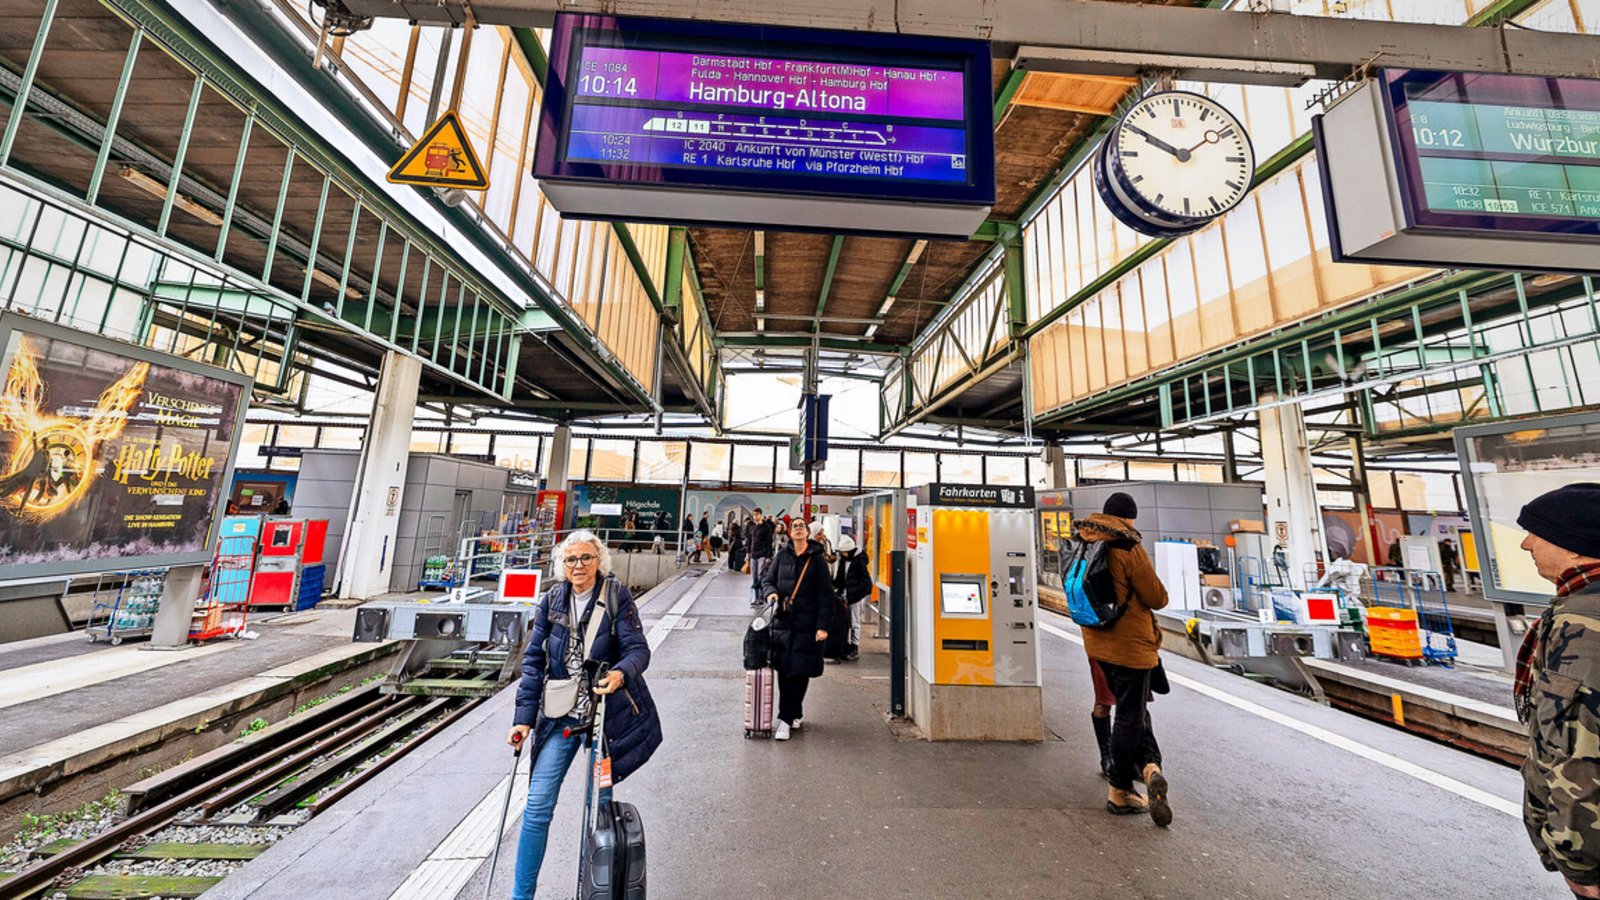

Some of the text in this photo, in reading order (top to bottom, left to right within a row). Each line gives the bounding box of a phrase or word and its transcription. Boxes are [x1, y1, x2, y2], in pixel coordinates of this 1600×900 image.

[603, 63, 628, 73] 1084
[692, 56, 750, 69] Darmstadt
[754, 61, 773, 71] Hbf
[784, 62, 871, 77] Frankfurt(M)Hbf
[883, 69, 916, 80] Hanau
[919, 72, 938, 81] Hbf
[580, 75, 637, 96] 10:14
[691, 68, 722, 80] Fulda
[733, 72, 785, 84] Hannover
[789, 75, 808, 85] Hbf
[820, 78, 867, 91] Hamburg
[870, 81, 888, 91] Hbf
[689, 82, 866, 111] Hamburg-Altona
[671, 121, 682, 130] 12
[694, 123, 704, 131] 11
[759, 116, 766, 125] E
[1420, 115, 1428, 124] 8
[1506, 120, 1571, 134] Ludwigsburg
[602, 135, 631, 146] 10:24
[1412, 127, 1465, 147] 10:12
[1509, 132, 1600, 155] Würzbur
[601, 148, 630, 159] 11:32
[684, 141, 924, 164] IC 2040 Ankunft von Münster (Westf) Hbf
[683, 153, 904, 176] RE 1 Karlsruhe Hbf via Pforzheim Hbf
[1528, 190, 1542, 200] RE
[1546, 191, 1553, 200] 1
[1531, 203, 1600, 215] ICE 571 Ank
[155, 408, 201, 428] MAGIE
[112, 444, 215, 487] Harry Potter
[188, 488, 208, 496] KIND
[939, 486, 998, 498] Fahrkarten
[625, 500, 661, 510] Högschde
